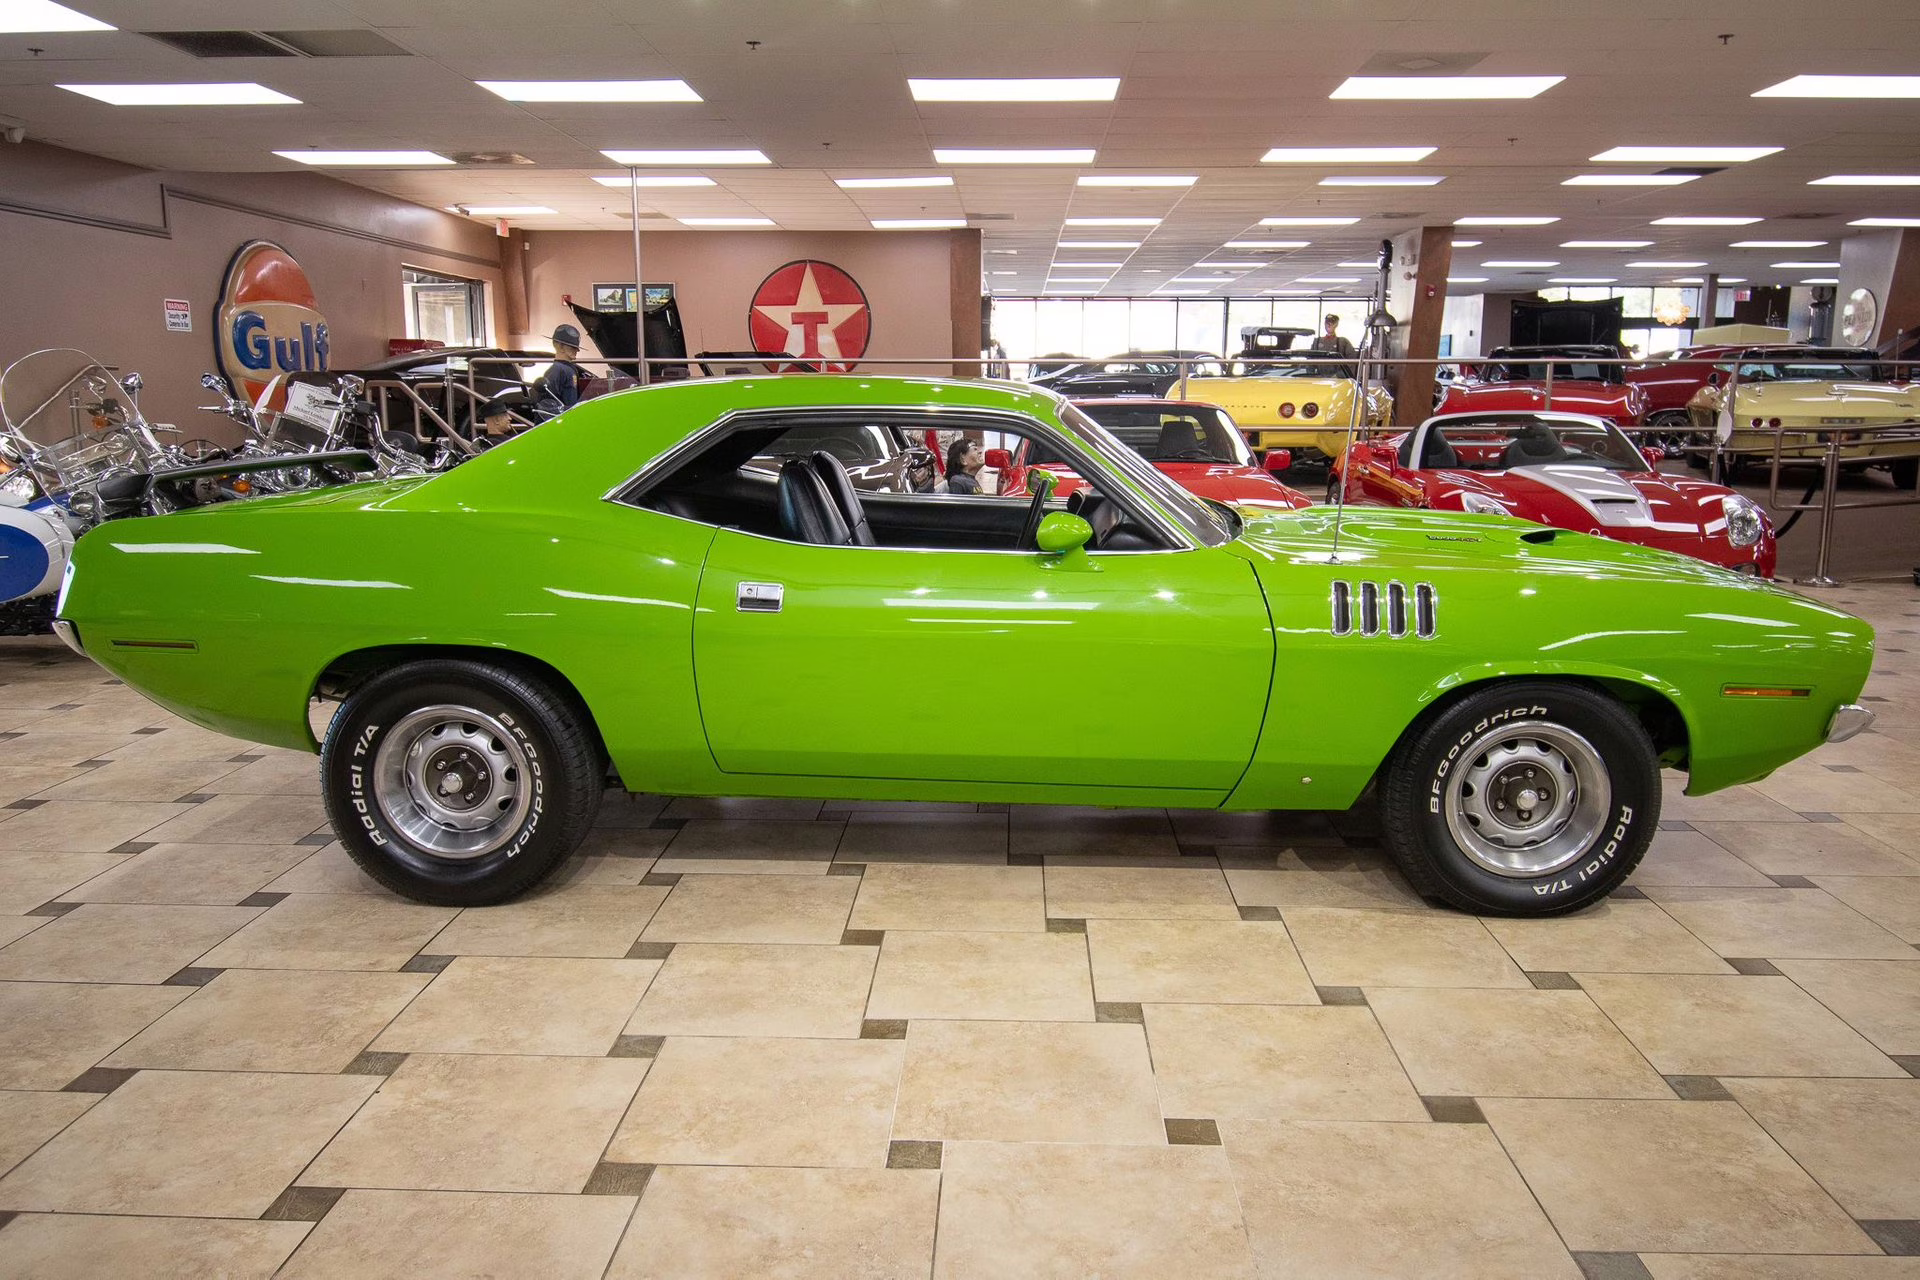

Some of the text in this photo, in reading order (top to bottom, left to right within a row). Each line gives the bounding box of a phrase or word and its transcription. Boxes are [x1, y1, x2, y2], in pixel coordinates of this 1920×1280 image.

[166, 302, 188, 311] WARNING
[232, 310, 329, 372] Gulf
[791, 311, 829, 359] T
[351, 724, 388, 846] Radial T/A
[498, 712, 544, 858] BFGoodrich
[1430, 705, 1547, 814] BFGoodrich
[1532, 805, 1633, 896] Radial T/A
